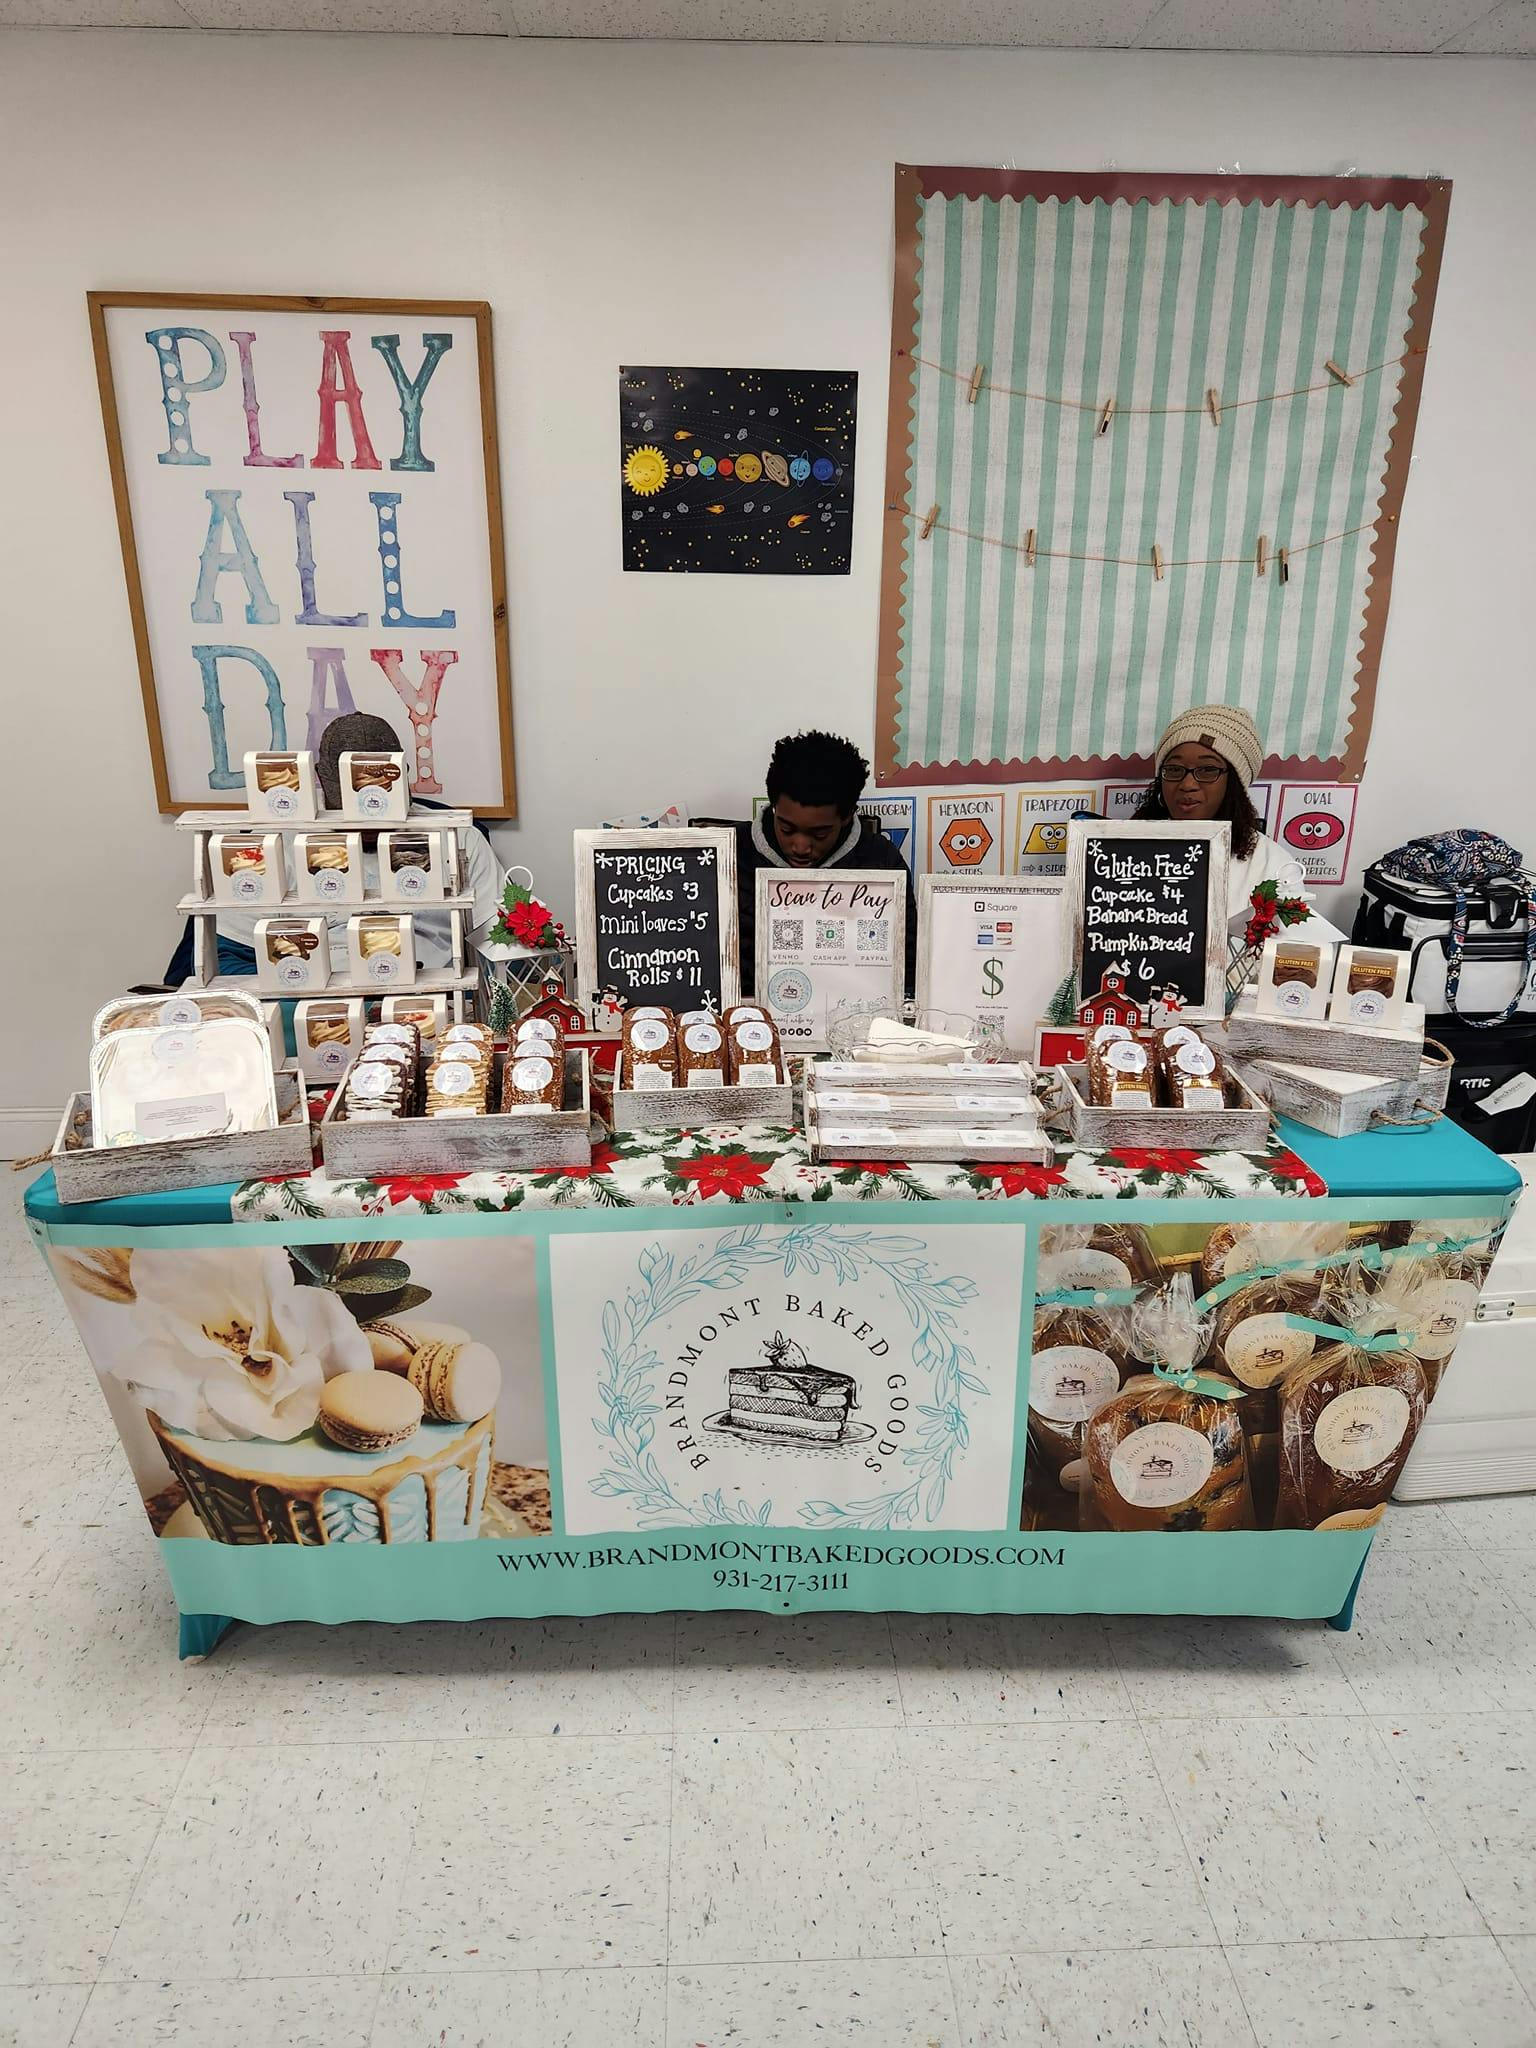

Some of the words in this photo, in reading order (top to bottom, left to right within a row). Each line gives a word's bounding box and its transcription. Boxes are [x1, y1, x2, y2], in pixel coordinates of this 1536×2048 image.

[145, 326, 453, 472] PLAY
[190, 489, 457, 628] ALL
[192, 645, 459, 794] DAY
[939, 801, 994, 816] HEXAGON
[1025, 799, 1089, 812] TRAPEZOID
[1304, 792, 1333, 805] OVAL
[616, 856, 685, 875] PRICING
[1095, 853, 1152, 879] Gluten
[1154, 854, 1195, 877] Free
[608, 884, 673, 908] Cupcakes
[682, 882, 699, 900] $3
[770, 881, 817, 908] Scan
[821, 883, 844, 910] to
[849, 884, 892, 920] Pay
[979, 886, 1017, 894] PAYMENT
[1091, 886, 1155, 907] Cupcake
[1162, 884, 1184, 905] $4
[987, 903, 1018, 912] Square
[1086, 906, 1145, 926] Banana
[1146, 907, 1188, 925] Bread
[641, 911, 688, 934] loaves
[1087, 932, 1148, 956] Pumpkin
[1149, 932, 1194, 954] Bread
[608, 947, 700, 969] Cinnamon
[627, 966, 671, 987] Rolls
[1353, 966, 1376, 974] GLUTEN
[1460, 1078, 1491, 1089] RTIC
[666, 1298, 761, 1471] BRANDMONT
[785, 1294, 889, 1358] BAKED
[863, 1374, 909, 1473] GOODS
[497, 1540, 1065, 1571] WWW.BRANDMONTBAKEDGOODS.COM
[713, 1569, 849, 1593] 931-217-3111
